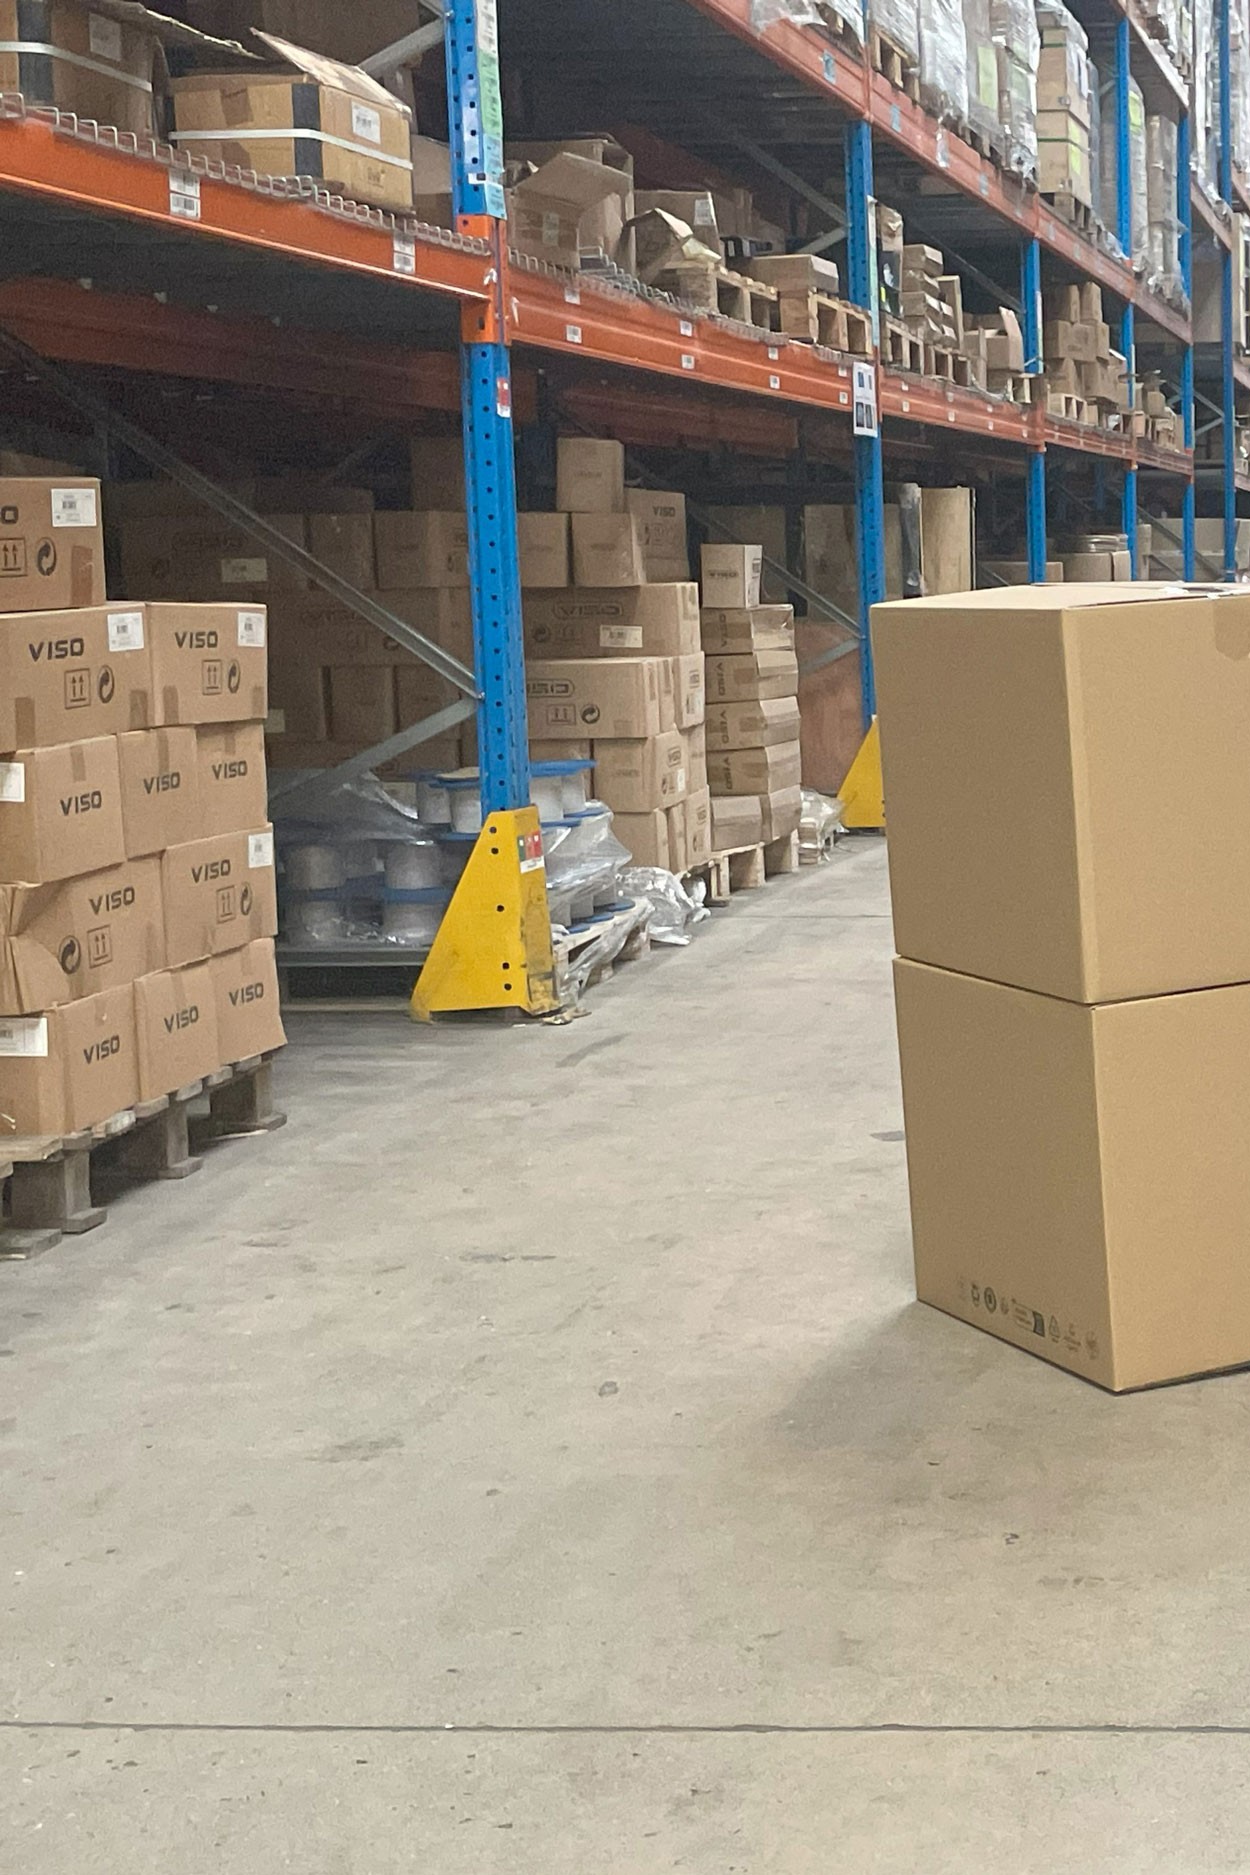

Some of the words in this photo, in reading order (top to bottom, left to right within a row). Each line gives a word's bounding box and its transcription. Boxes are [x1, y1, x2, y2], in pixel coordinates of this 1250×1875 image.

[652, 506, 675, 517] VISO
[29, 638, 85, 662] VISO
[174, 630, 219, 649] VISO
[211, 760, 249, 780] VISO
[143, 772, 181, 795] VISO
[60, 790, 102, 816] VISO
[191, 858, 232, 884] VISO
[88, 886, 136, 915] VISO
[228, 981, 264, 1007] VISO
[163, 1005, 200, 1033] VISO
[83, 1034, 121, 1064] VISO
